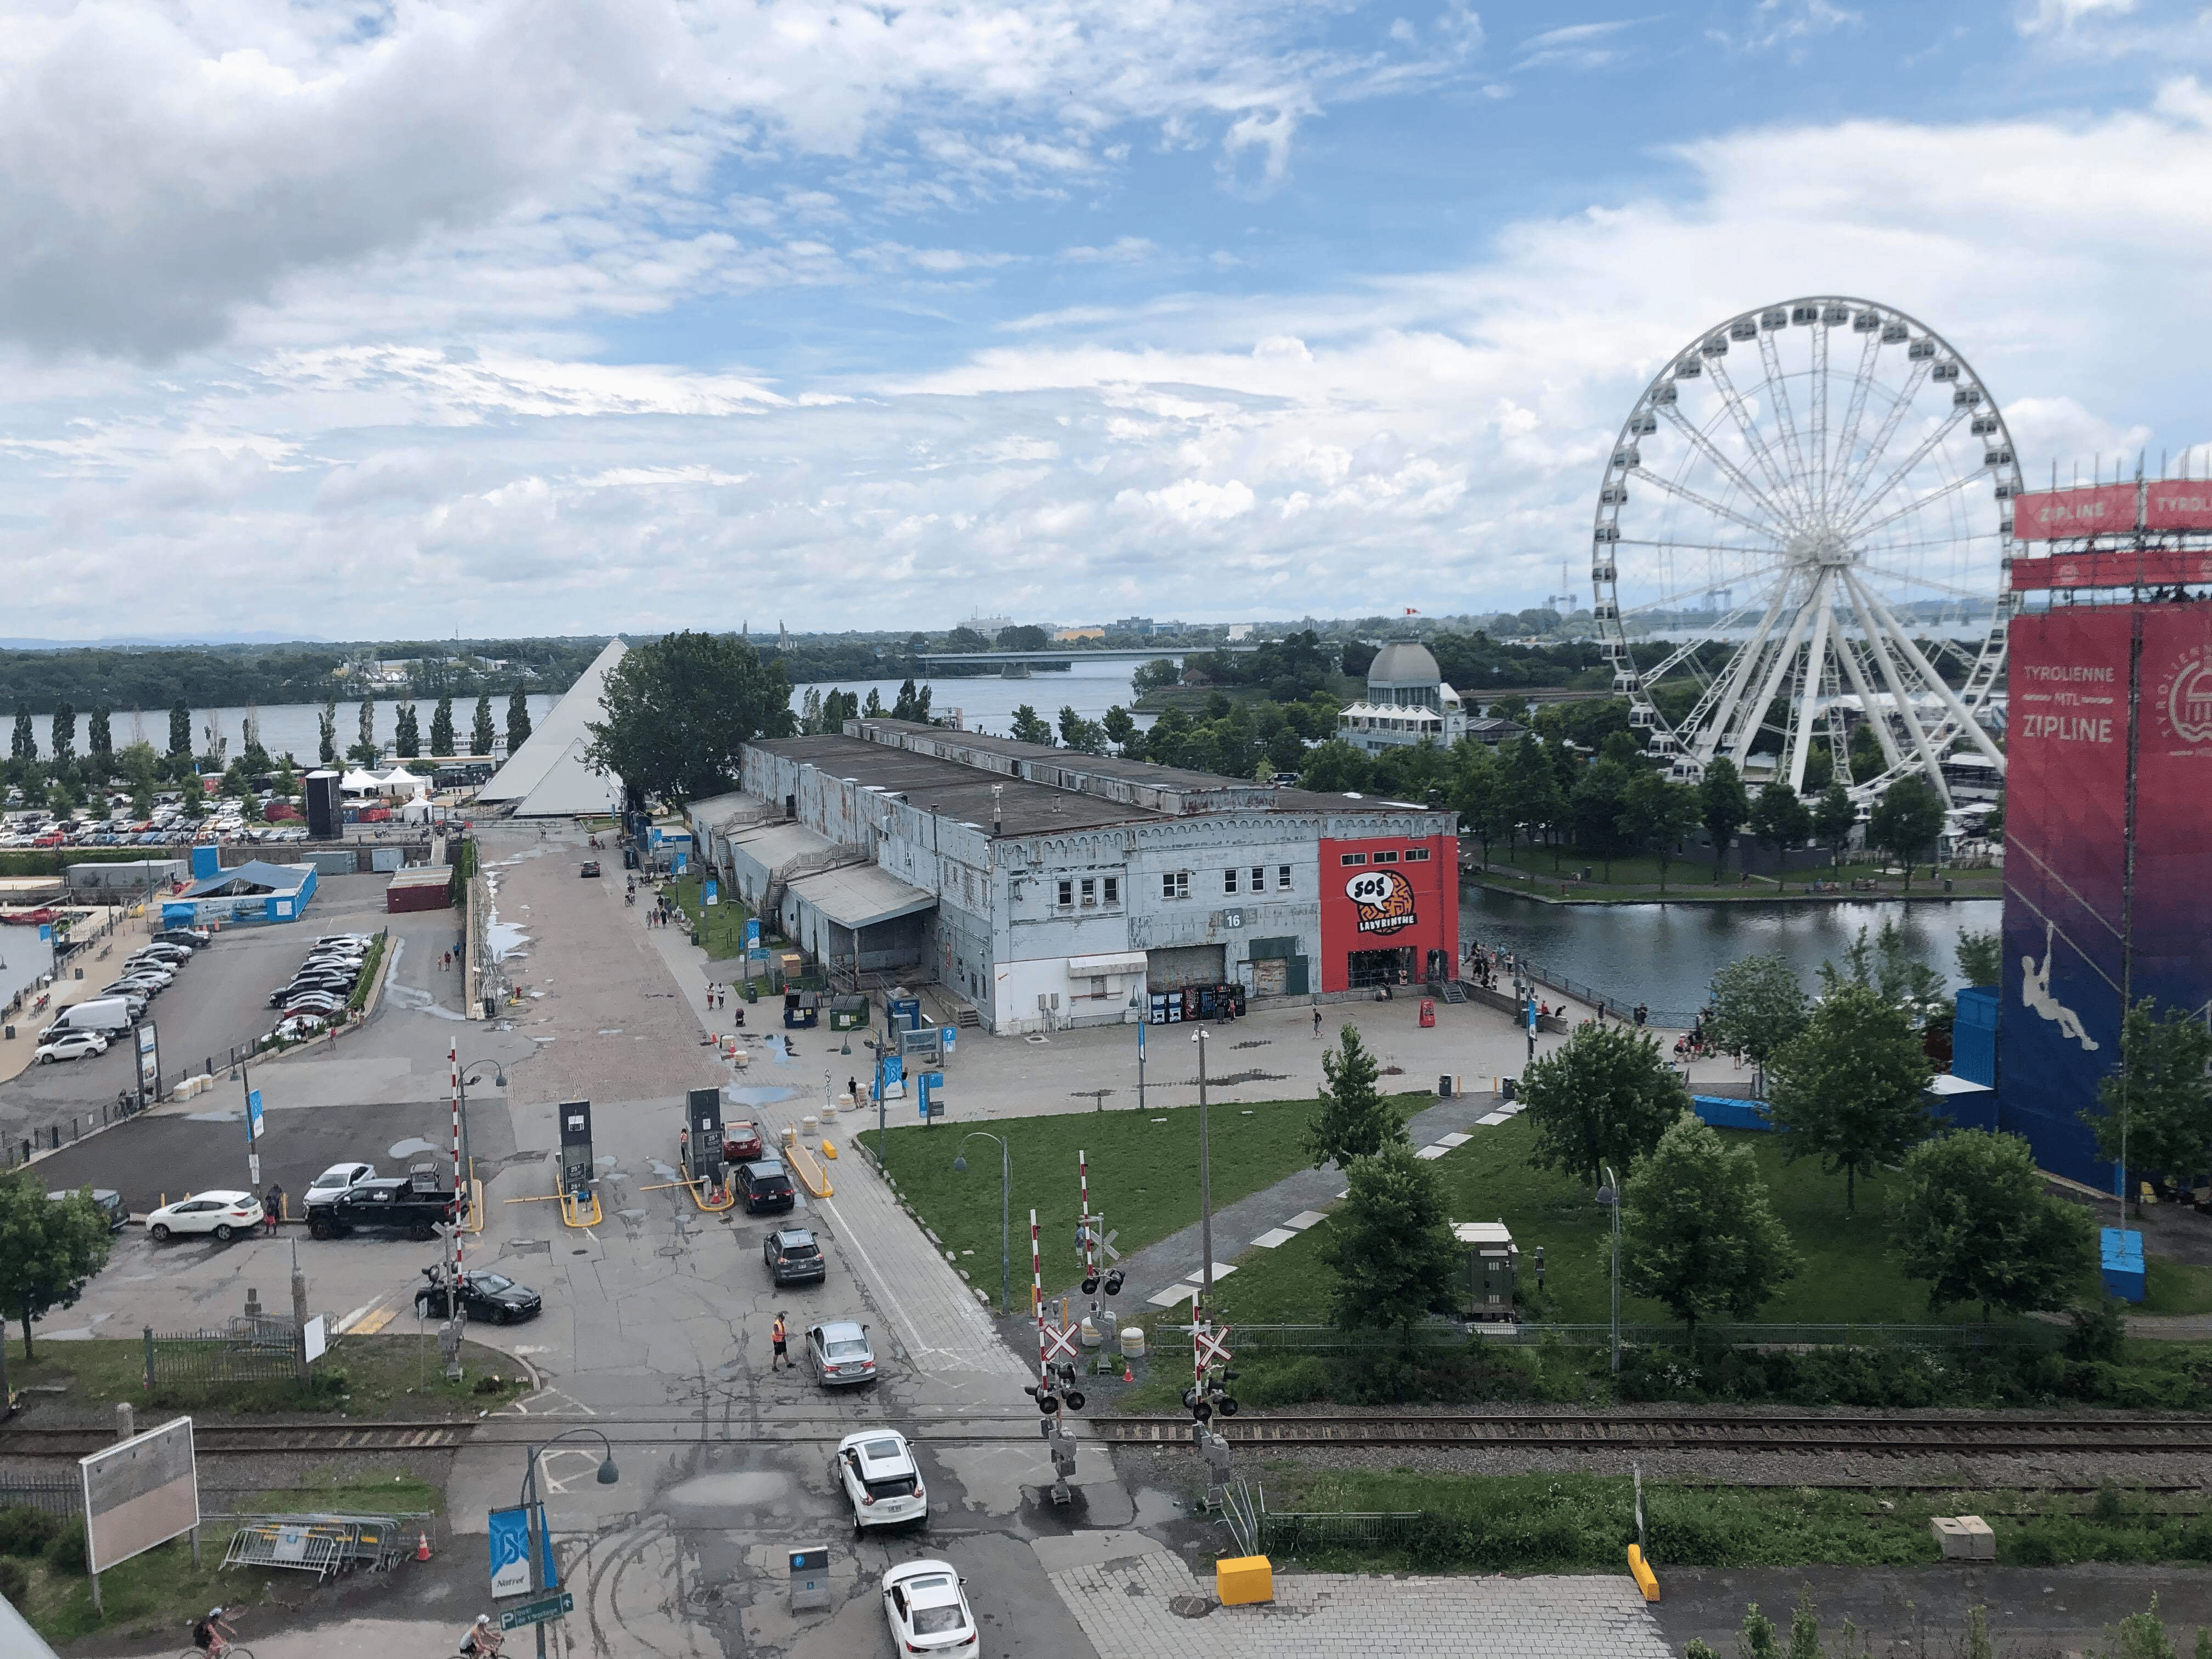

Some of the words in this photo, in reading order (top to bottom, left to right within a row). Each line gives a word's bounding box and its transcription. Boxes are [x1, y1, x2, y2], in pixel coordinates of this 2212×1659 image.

[2040, 502, 2104, 522] ZIPLINE
[2158, 496, 2212, 511] TYROL
[2024, 665, 2114, 682] TYROLIENNE
[2055, 692, 2080, 706] MTL
[2022, 715, 2113, 743] ZIPLINE
[1354, 876, 1385, 898] SOS
[1227, 915, 1240, 927] 16
[1359, 915, 1414, 932] LABYRINTHE
[501, 1612, 514, 1629] P
